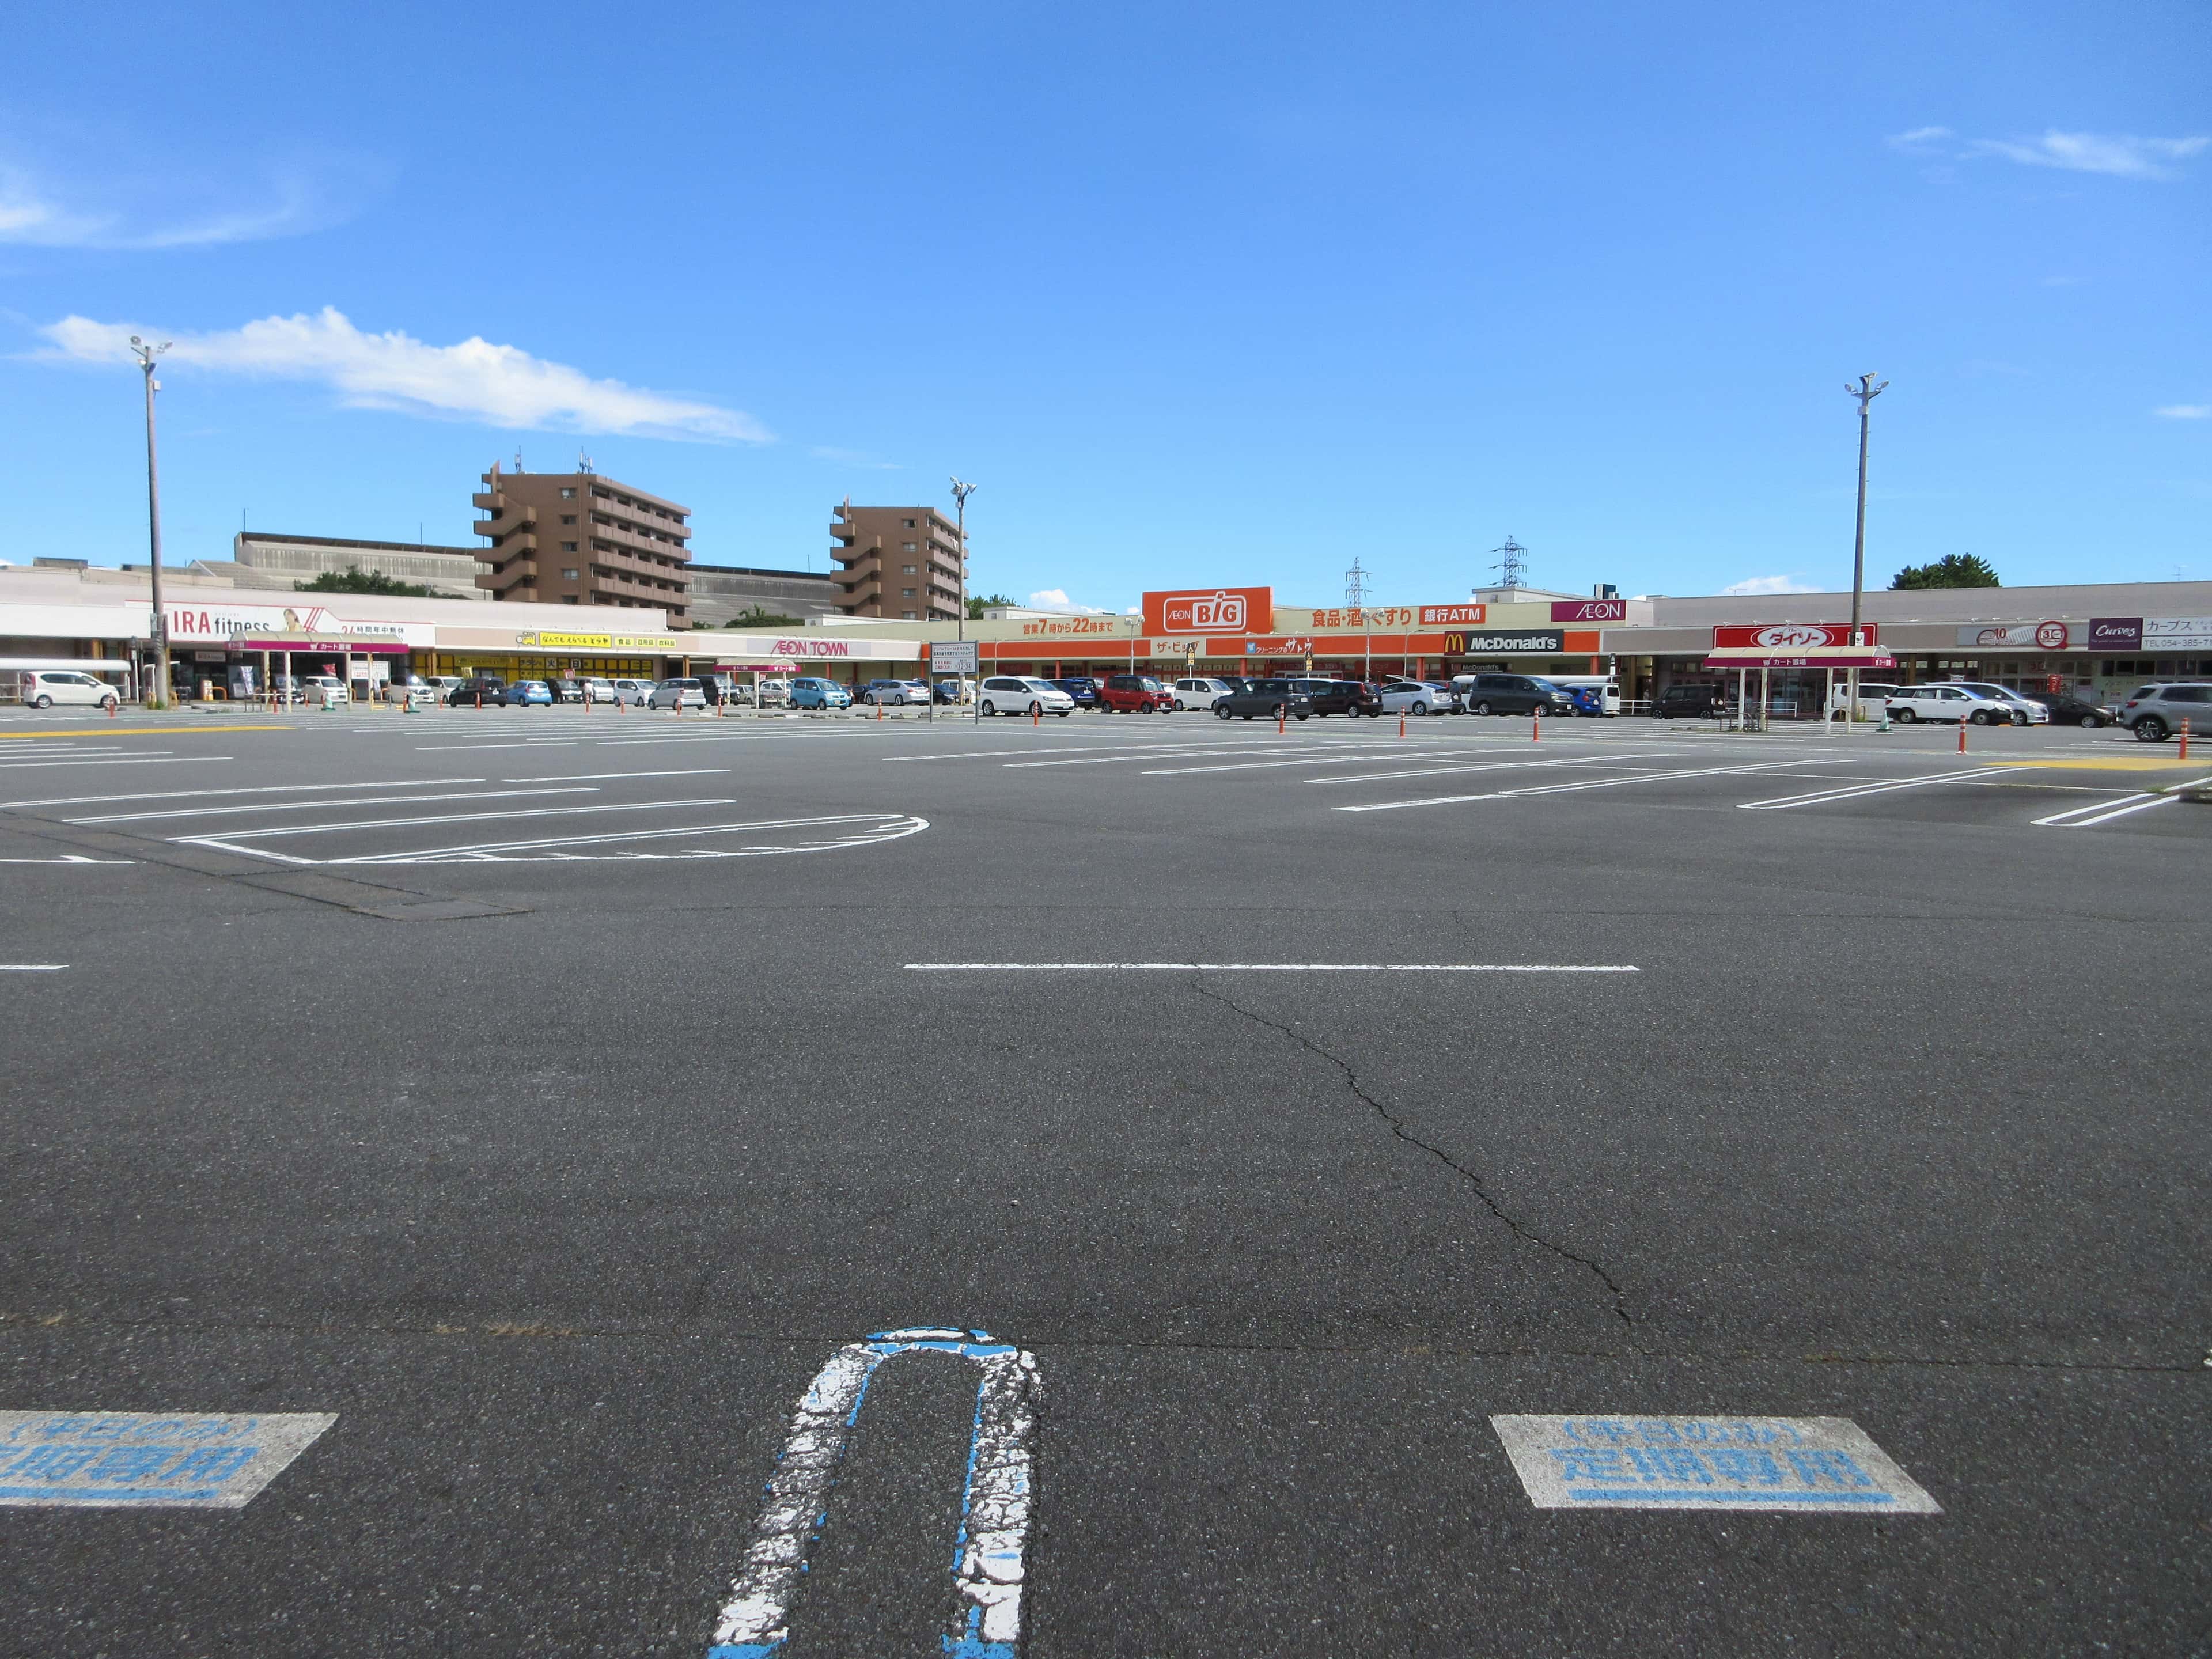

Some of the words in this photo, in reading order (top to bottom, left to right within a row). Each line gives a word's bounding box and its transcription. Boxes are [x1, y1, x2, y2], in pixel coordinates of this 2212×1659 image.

[1424, 608, 1480, 622] 銀行ATM
[2095, 624, 2135, 637] Curves
[2147, 620, 2192, 632] カーブス
[1470, 636, 1557, 651] McDonald's
[1769, 631, 1819, 645] ダイソー
[2144, 639, 2160, 647] TEL
[810, 641, 848, 656] TOWN
